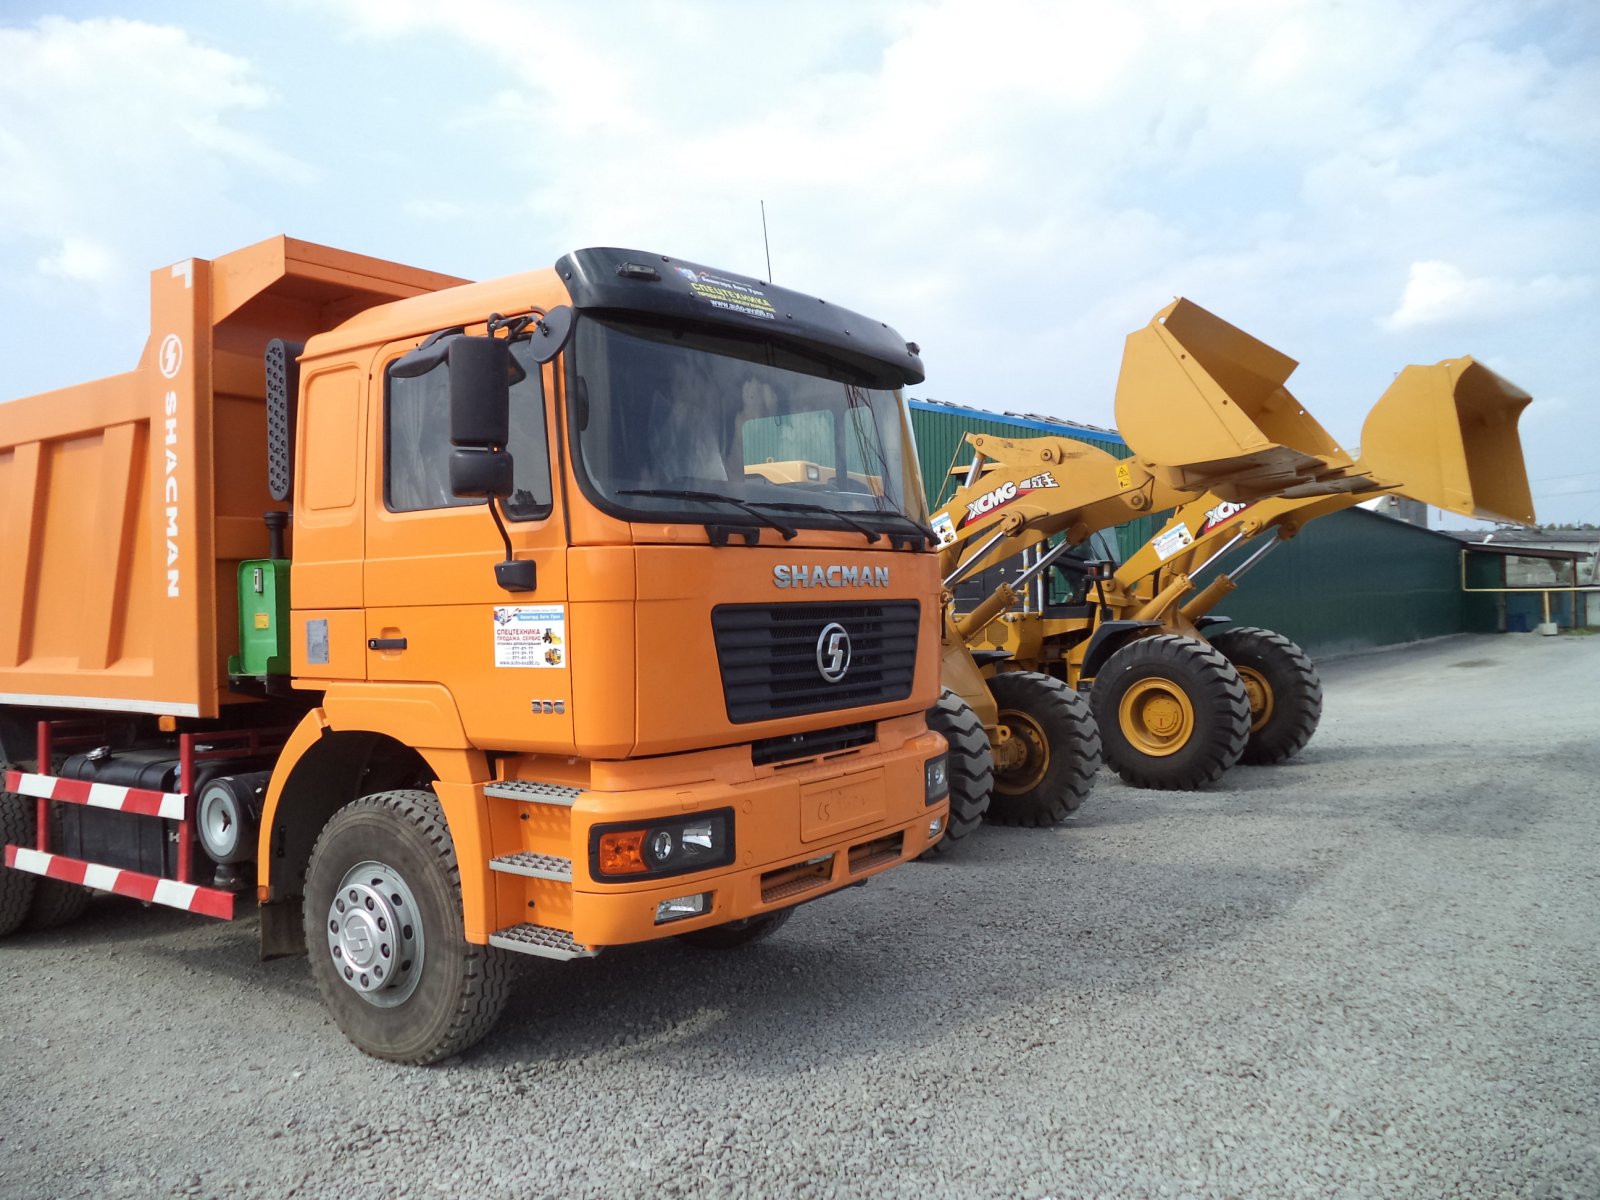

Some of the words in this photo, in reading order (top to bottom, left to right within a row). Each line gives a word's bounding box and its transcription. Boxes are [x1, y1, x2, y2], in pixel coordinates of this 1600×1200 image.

[690, 282, 771, 307] СПЕЦТЕХНИКА
[165, 391, 179, 597] SHACMAN
[966, 481, 1017, 520] XCMG
[773, 565, 889, 588] SHACMAN
[497, 628, 541, 636] СПЕЦТЕХНИКА
